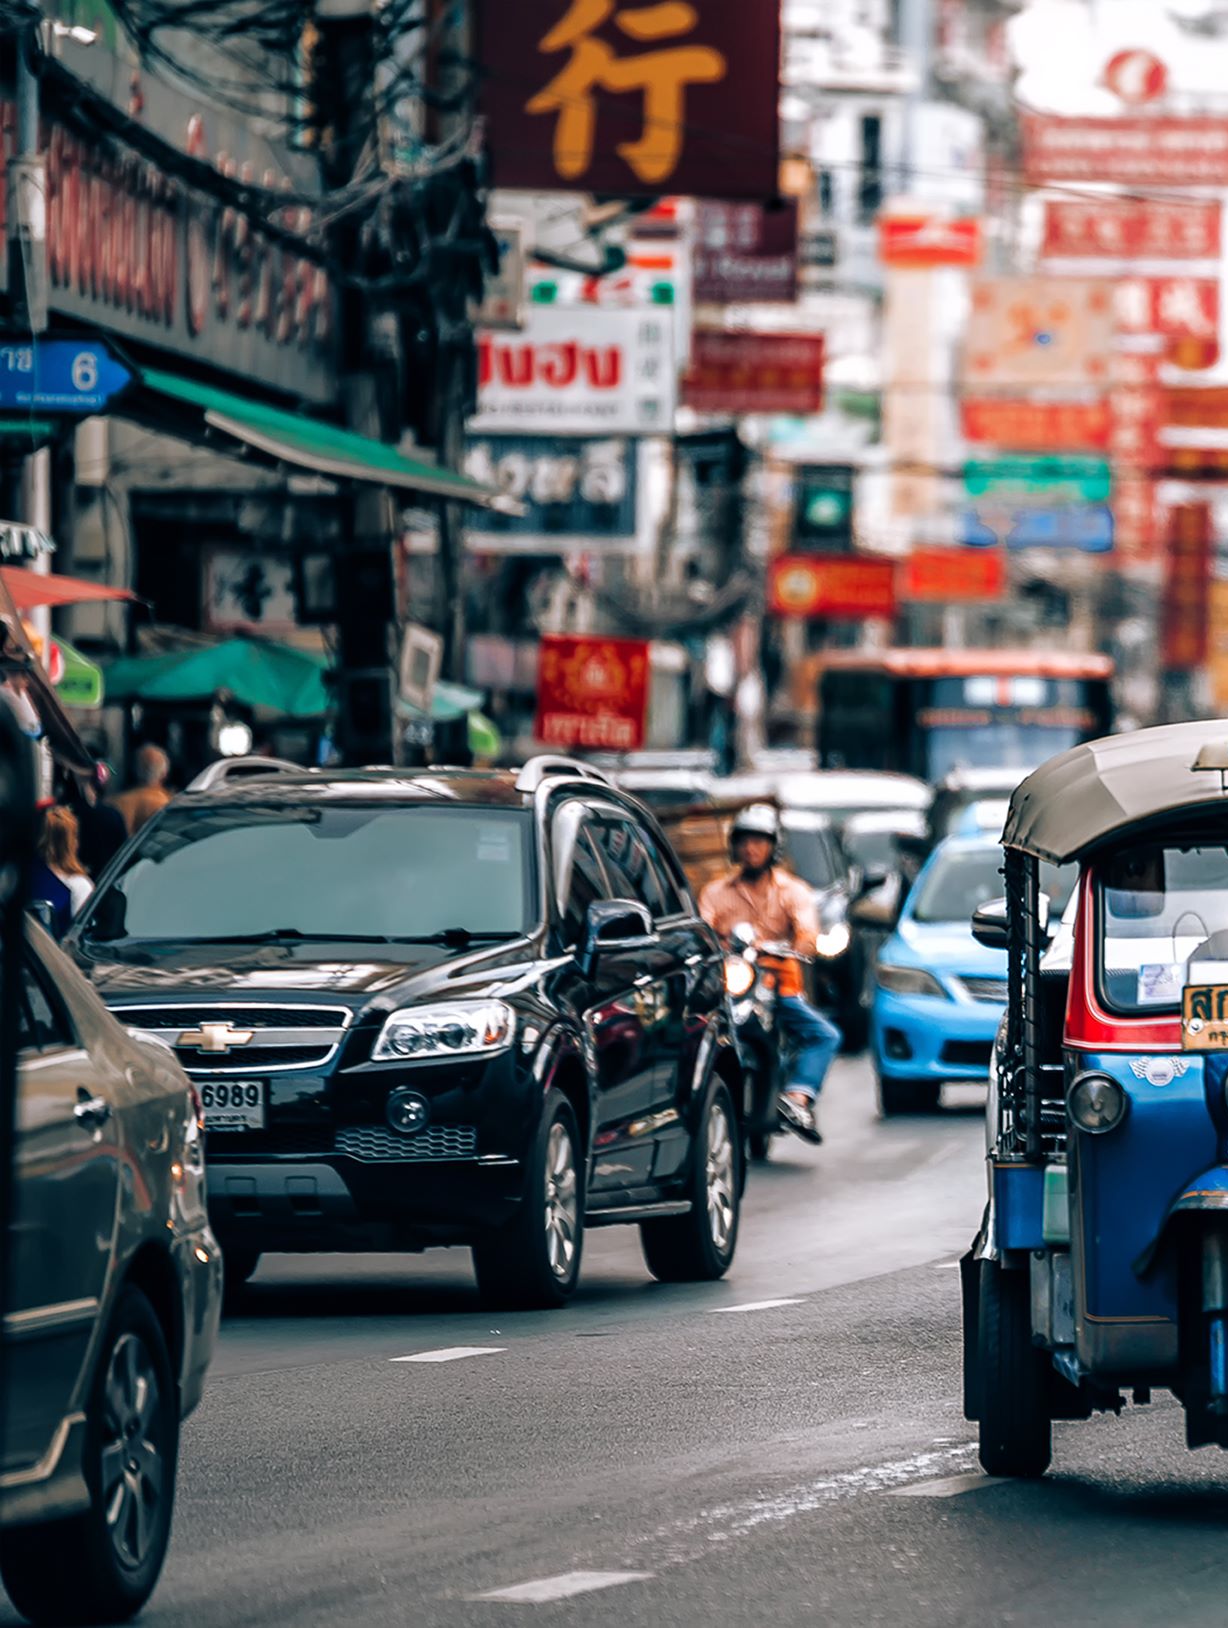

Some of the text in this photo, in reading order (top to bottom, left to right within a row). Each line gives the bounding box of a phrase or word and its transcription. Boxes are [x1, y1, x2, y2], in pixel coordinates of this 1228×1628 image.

[525, 0, 728, 184] 行
[71, 351, 98, 391] 6
[201, 1084, 259, 1108] 6989
